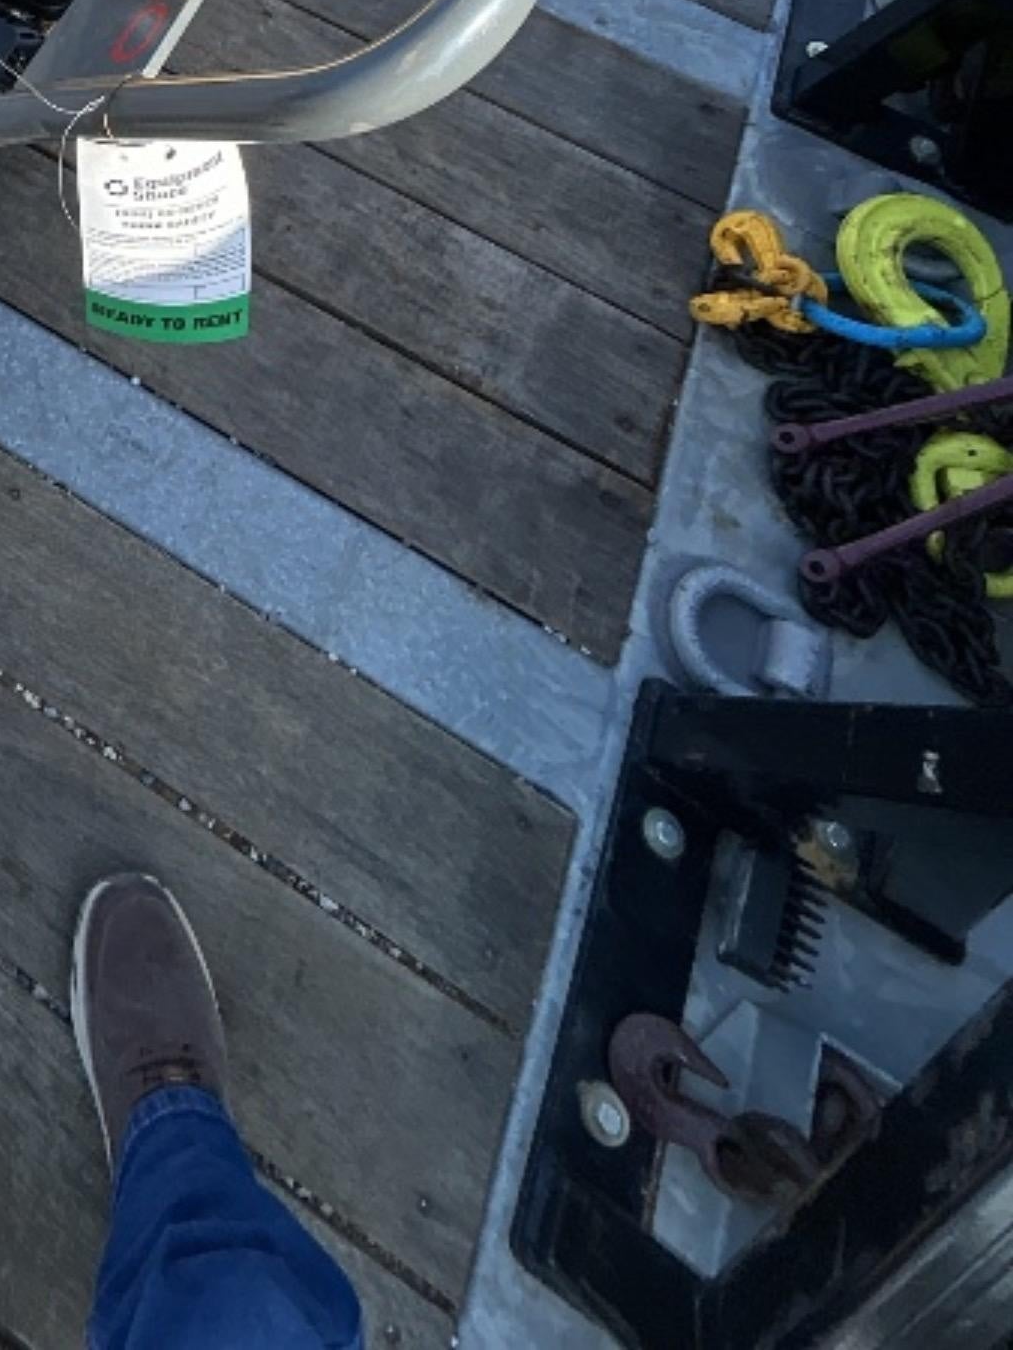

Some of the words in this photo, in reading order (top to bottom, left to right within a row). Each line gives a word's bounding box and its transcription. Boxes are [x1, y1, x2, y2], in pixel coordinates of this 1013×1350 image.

[91, 302, 156, 329] READY
[162, 316, 187, 331] TO
[193, 308, 244, 331] RENT
